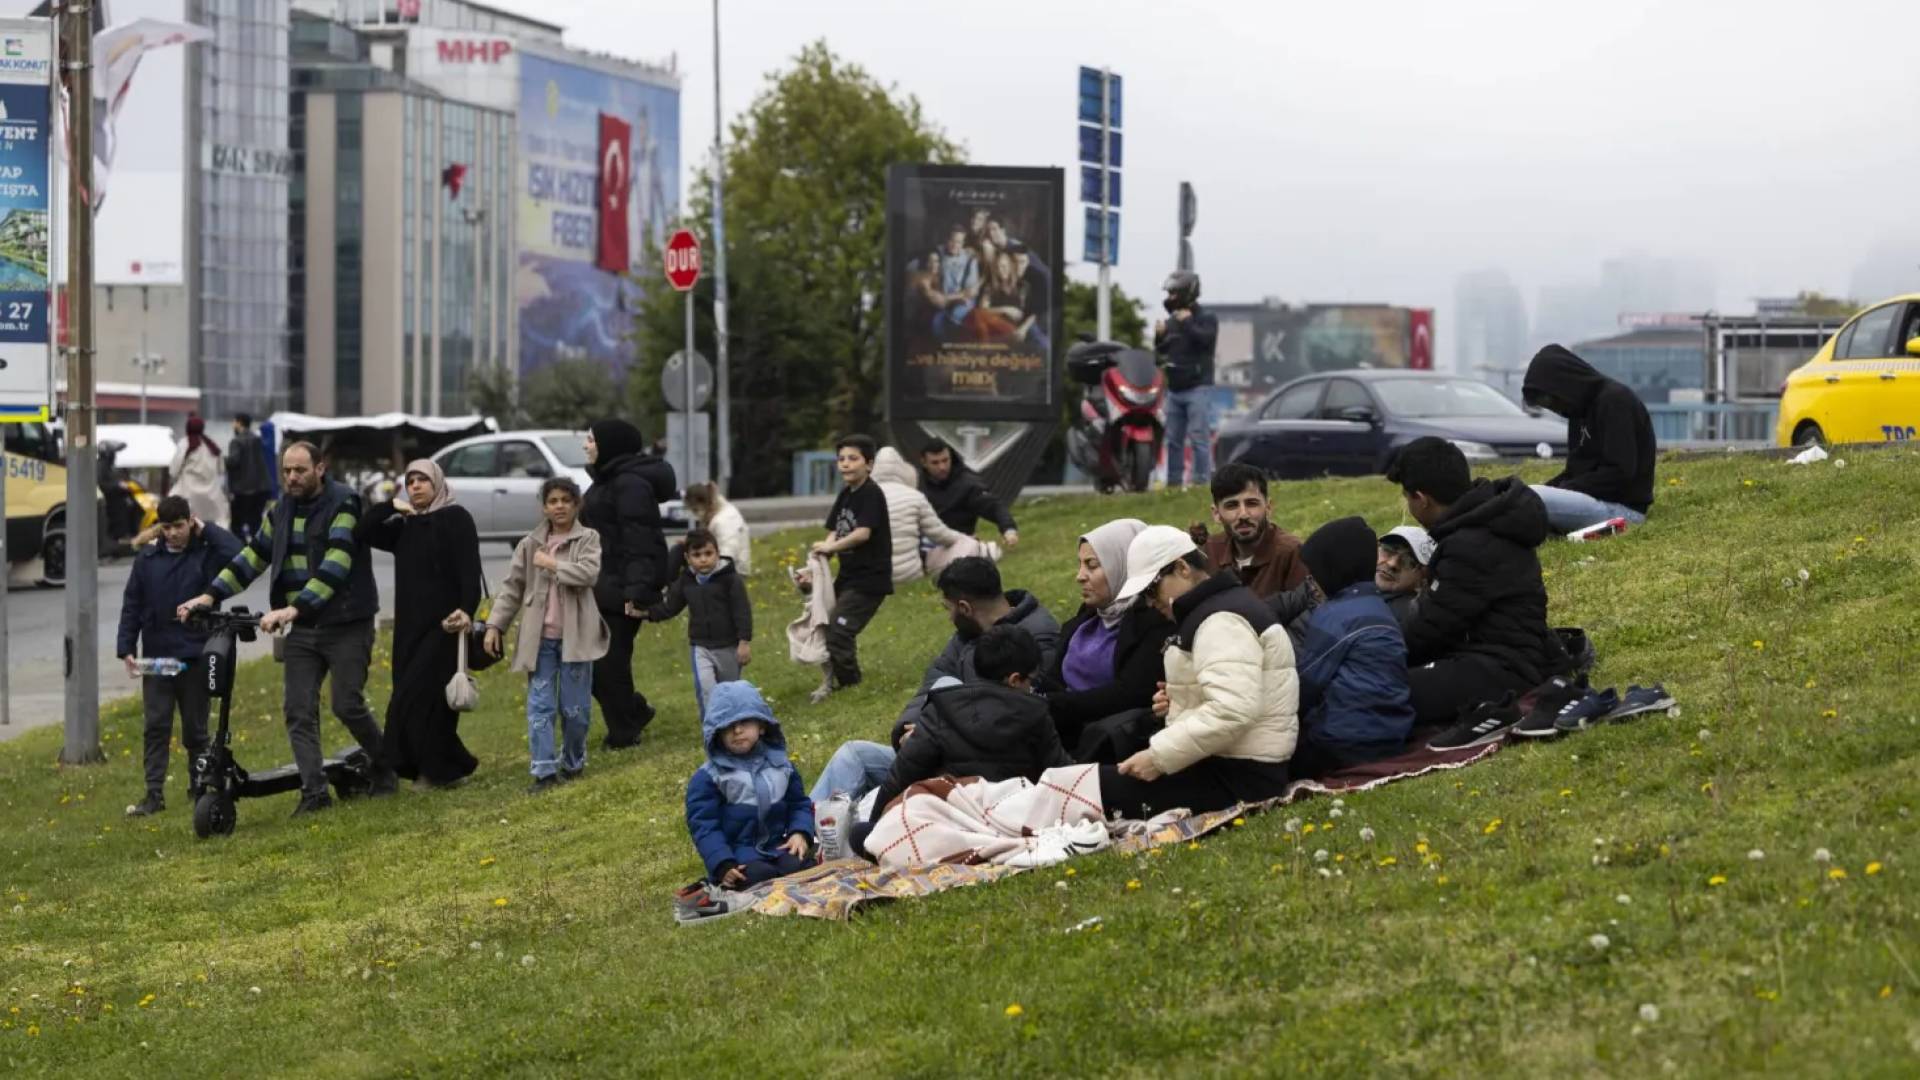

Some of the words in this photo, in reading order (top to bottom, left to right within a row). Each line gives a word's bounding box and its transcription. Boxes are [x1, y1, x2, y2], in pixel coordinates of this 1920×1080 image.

[437, 39, 513, 65] MHP
[667, 247, 698, 272] DUR
[8, 301, 33, 320] 27
